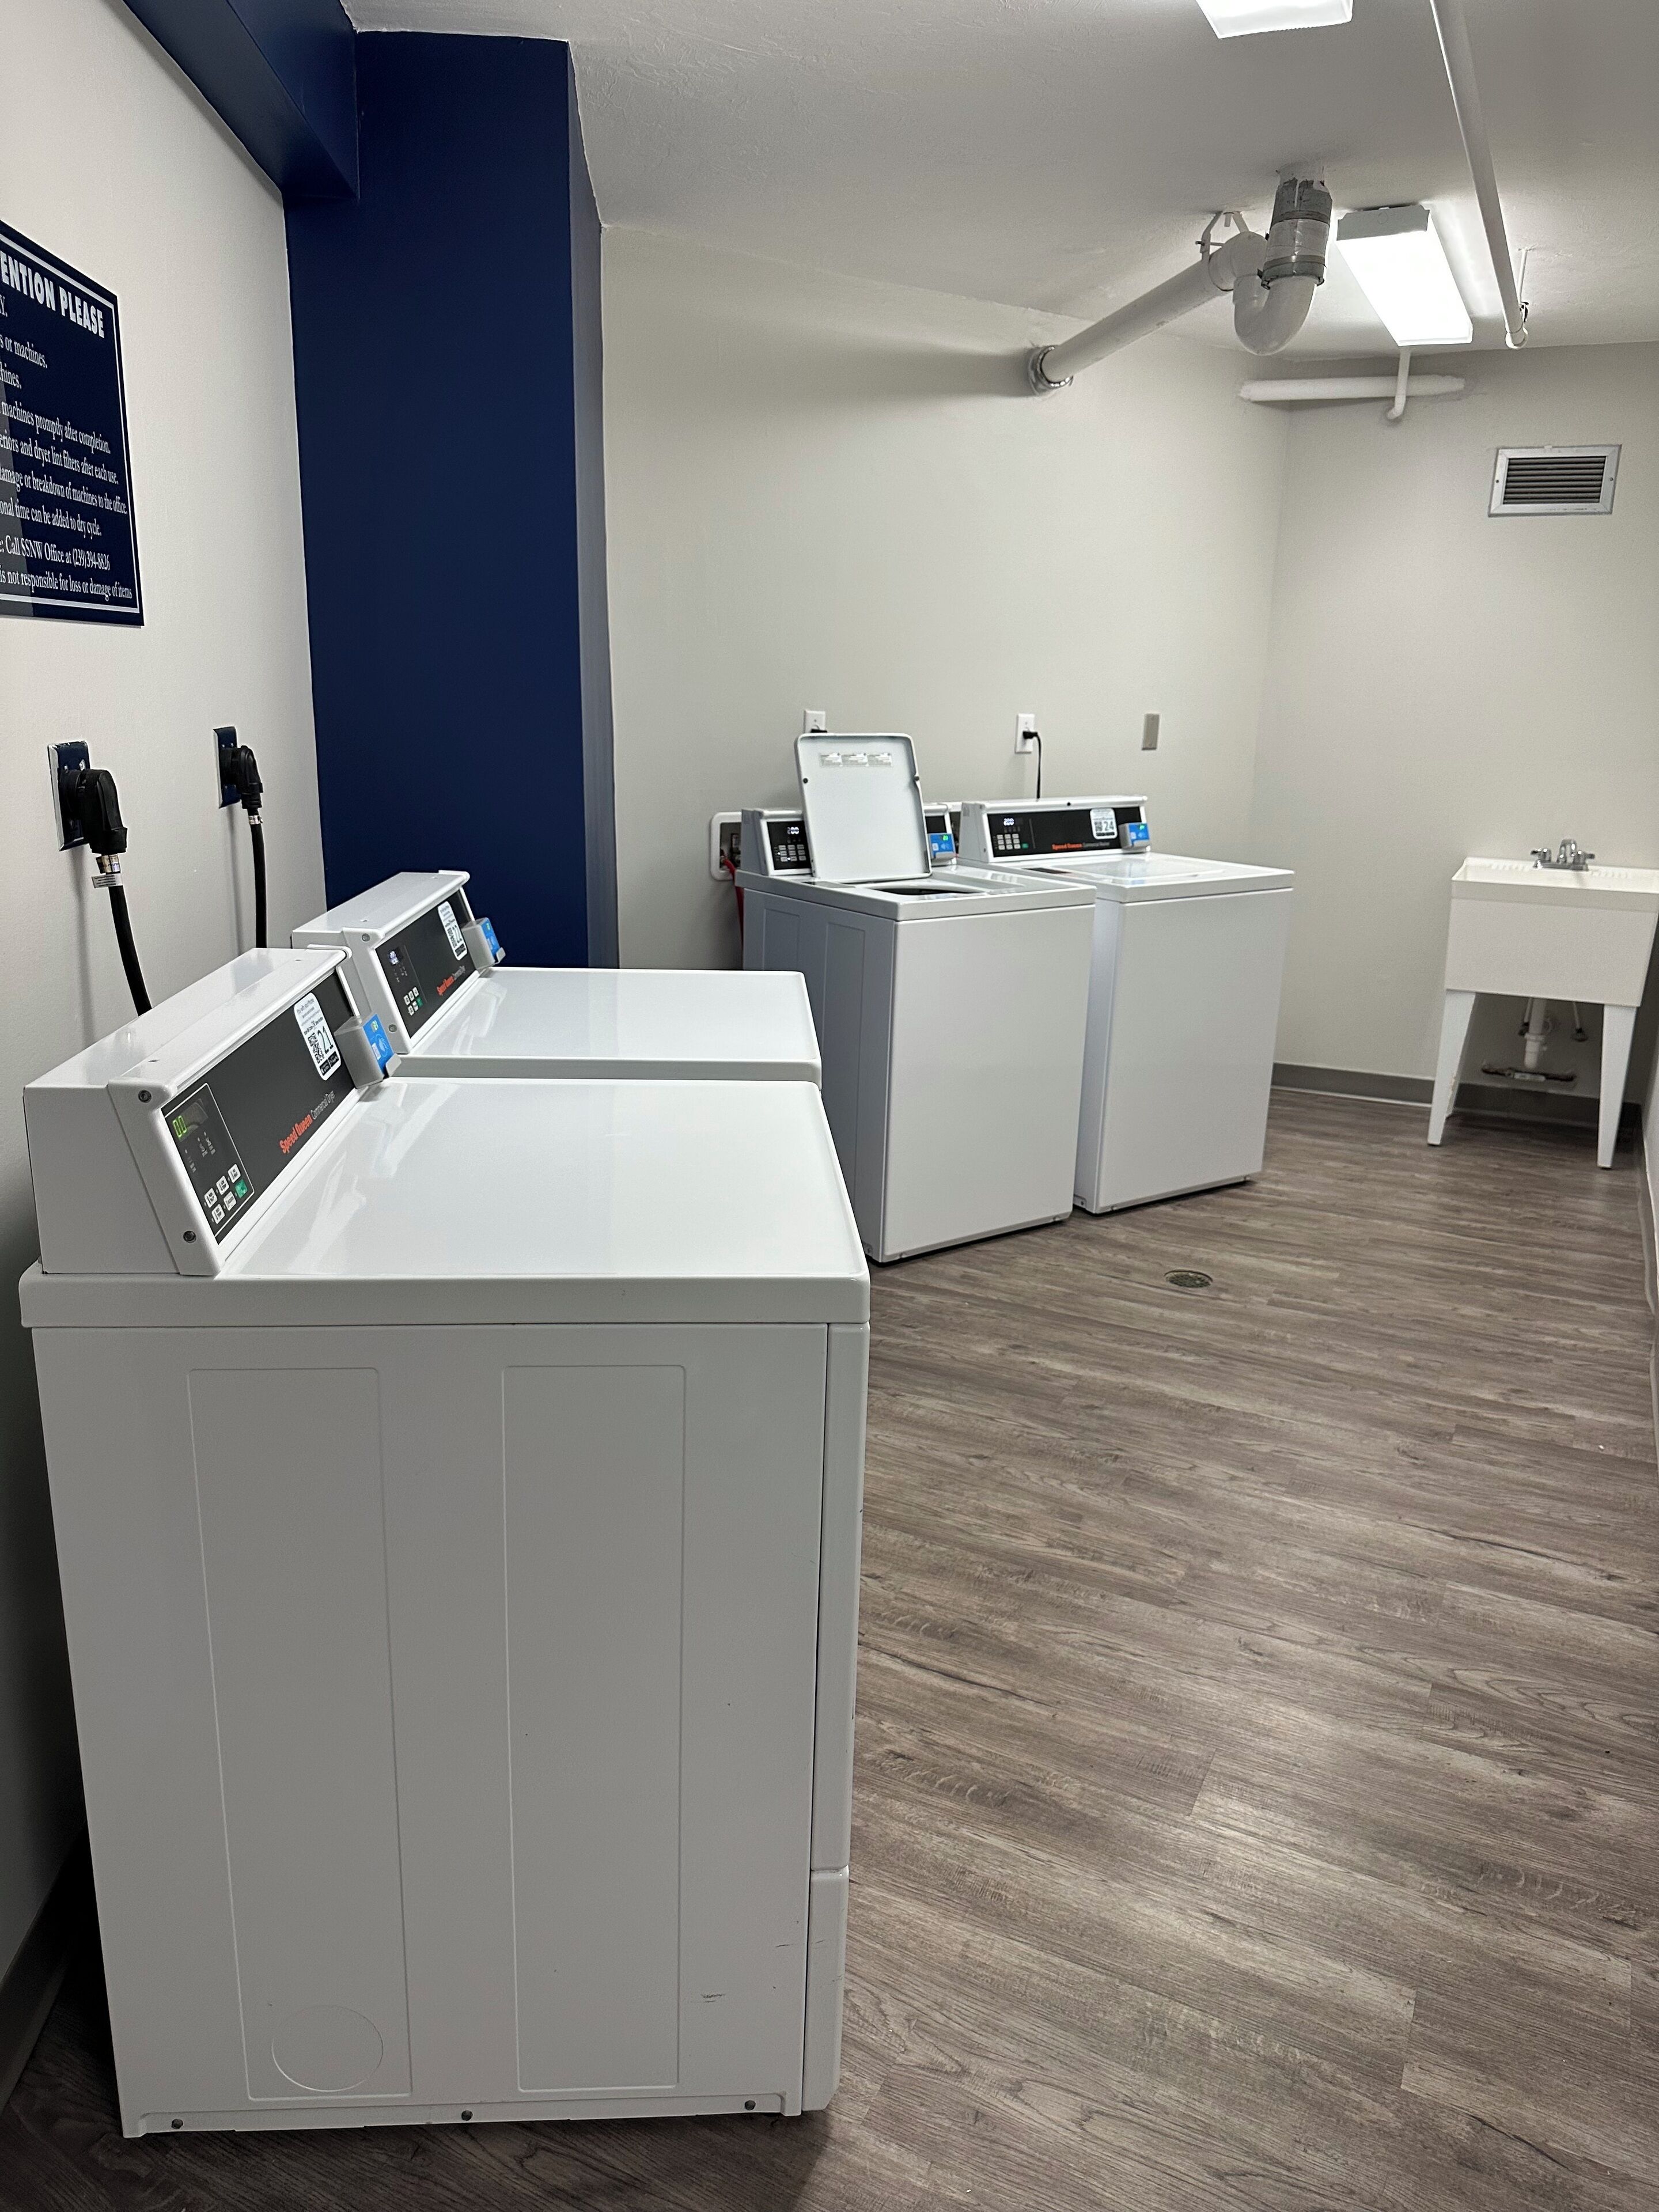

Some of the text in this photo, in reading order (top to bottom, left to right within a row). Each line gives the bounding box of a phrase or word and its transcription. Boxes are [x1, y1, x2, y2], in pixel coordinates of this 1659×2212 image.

[59, 286, 105, 339] PLEASE
[5, 337, 13, 353] or
[14, 342, 47, 369] machines.
[2, 401, 111, 454] machines promptly after completion.
[20, 438, 33, 457] and
[34, 440, 51, 467] dryer
[51, 446, 63, 467] lint
[63, 450, 80, 472] filters
[81, 457, 94, 477] after
[94, 463, 108, 481] each
[107, 471, 119, 484] use.
[24, 475, 31, 488] or
[31, 470, 65, 498] breakdown
[66, 482, 72, 500] of
[72, 486, 98, 507] machines
[98, 494, 104, 509] to
[104, 493, 113, 511] the
[113, 496, 128, 515] office.
[15, 498, 30, 520] time
[31, 508, 43, 523] can
[42, 505, 51, 525] be
[52, 509, 70, 529] added
[70, 516, 76, 531] to
[77, 514, 86, 539] dry
[87, 518, 102, 540] cycle.
[6, 535, 21, 555] Call
[21, 537, 43, 559] SSNW
[44, 542, 65, 563] Office
[65, 551, 72, 564] at
[73, 548, 86, 569] (239)
[86, 551, 111, 570] 394-8826
[7, 571, 20, 585] not
[21, 570, 58, 593] responsible
[59, 573, 69, 591] for
[69, 575, 81, 593] loss
[82, 582, 89, 593] or
[89, 578, 111, 602] damage
[112, 581, 118, 597] of
[118, 582, 132, 599] items
[1103, 820, 1115, 832] 24
[317, 1025, 334, 1054] 21
[279, 1127, 298, 1154] Speed
[294, 1114, 313, 1137] Queen
